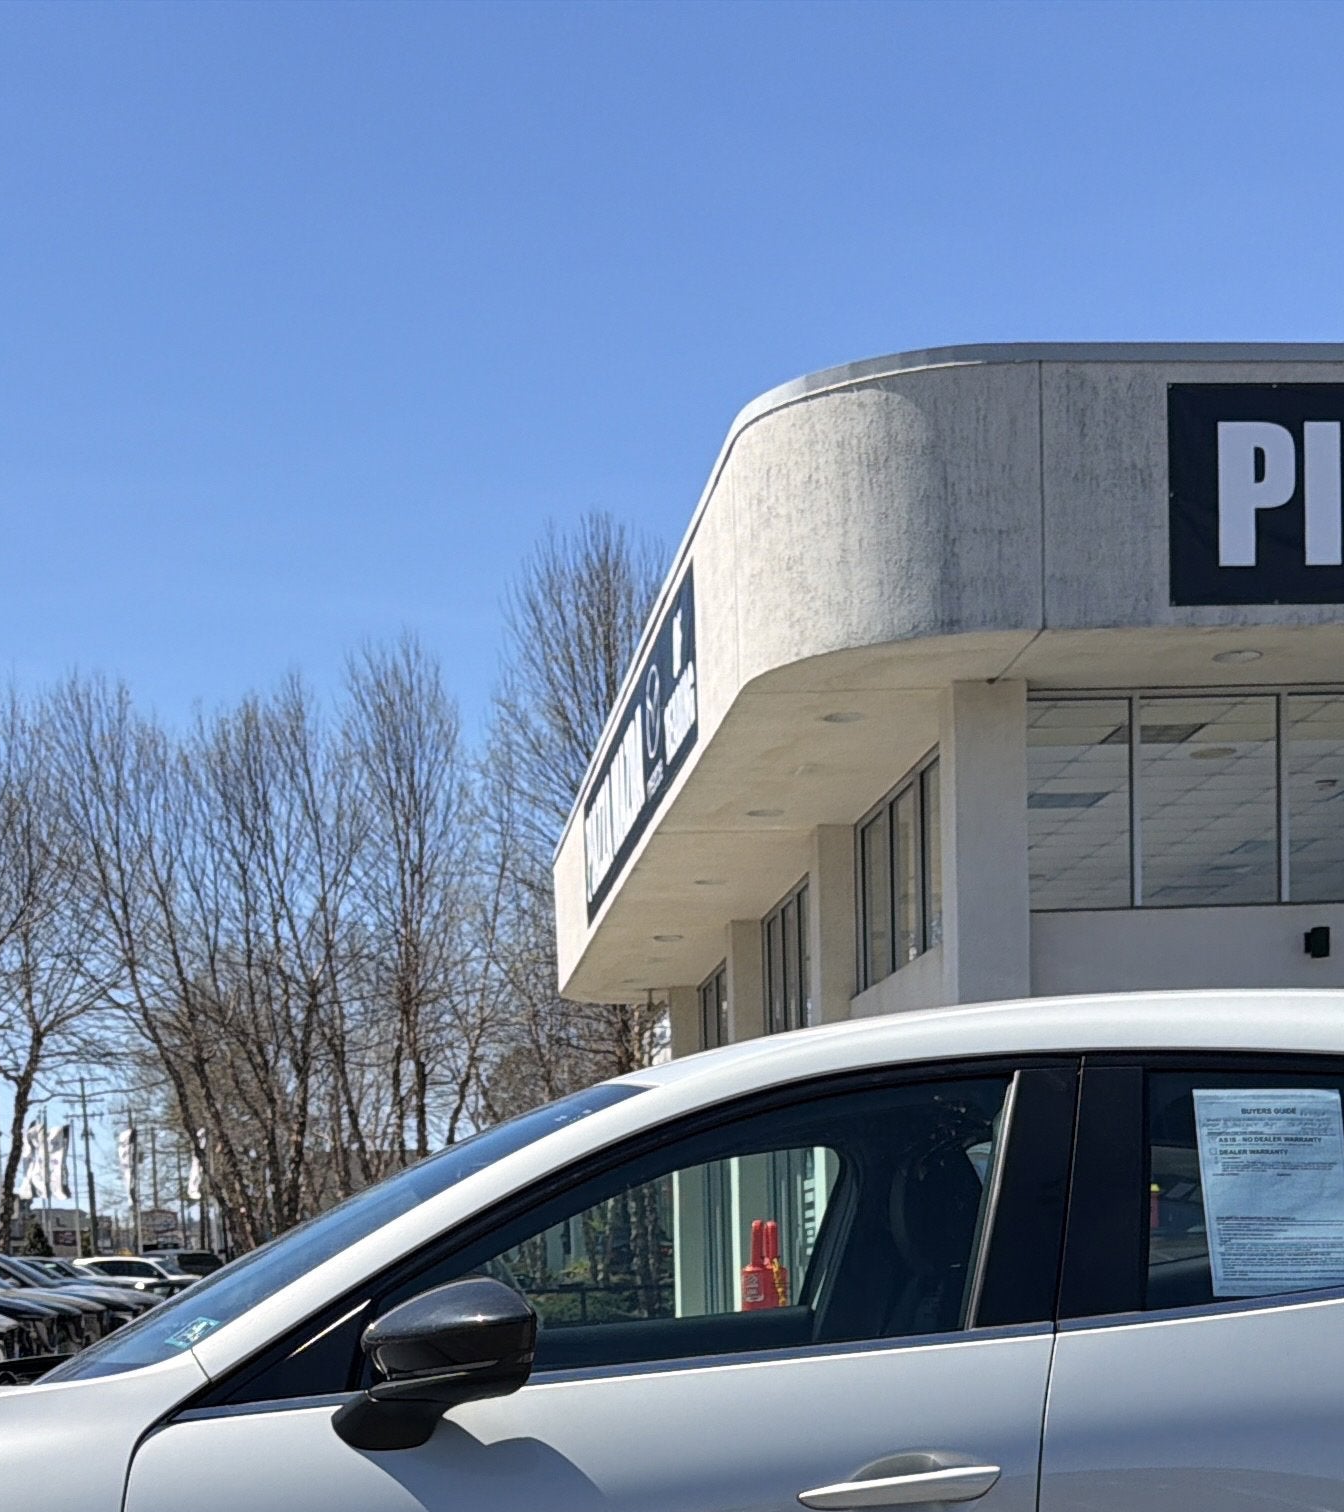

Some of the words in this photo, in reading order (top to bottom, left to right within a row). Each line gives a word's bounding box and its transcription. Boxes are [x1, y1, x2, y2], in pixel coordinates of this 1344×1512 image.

[1240, 1107, 1273, 1115] BUYERS
[1273, 1107, 1297, 1115] GUIDE
[1218, 1148, 1248, 1156] DEALER
[1248, 1148, 1289, 1156] WARRANTY
